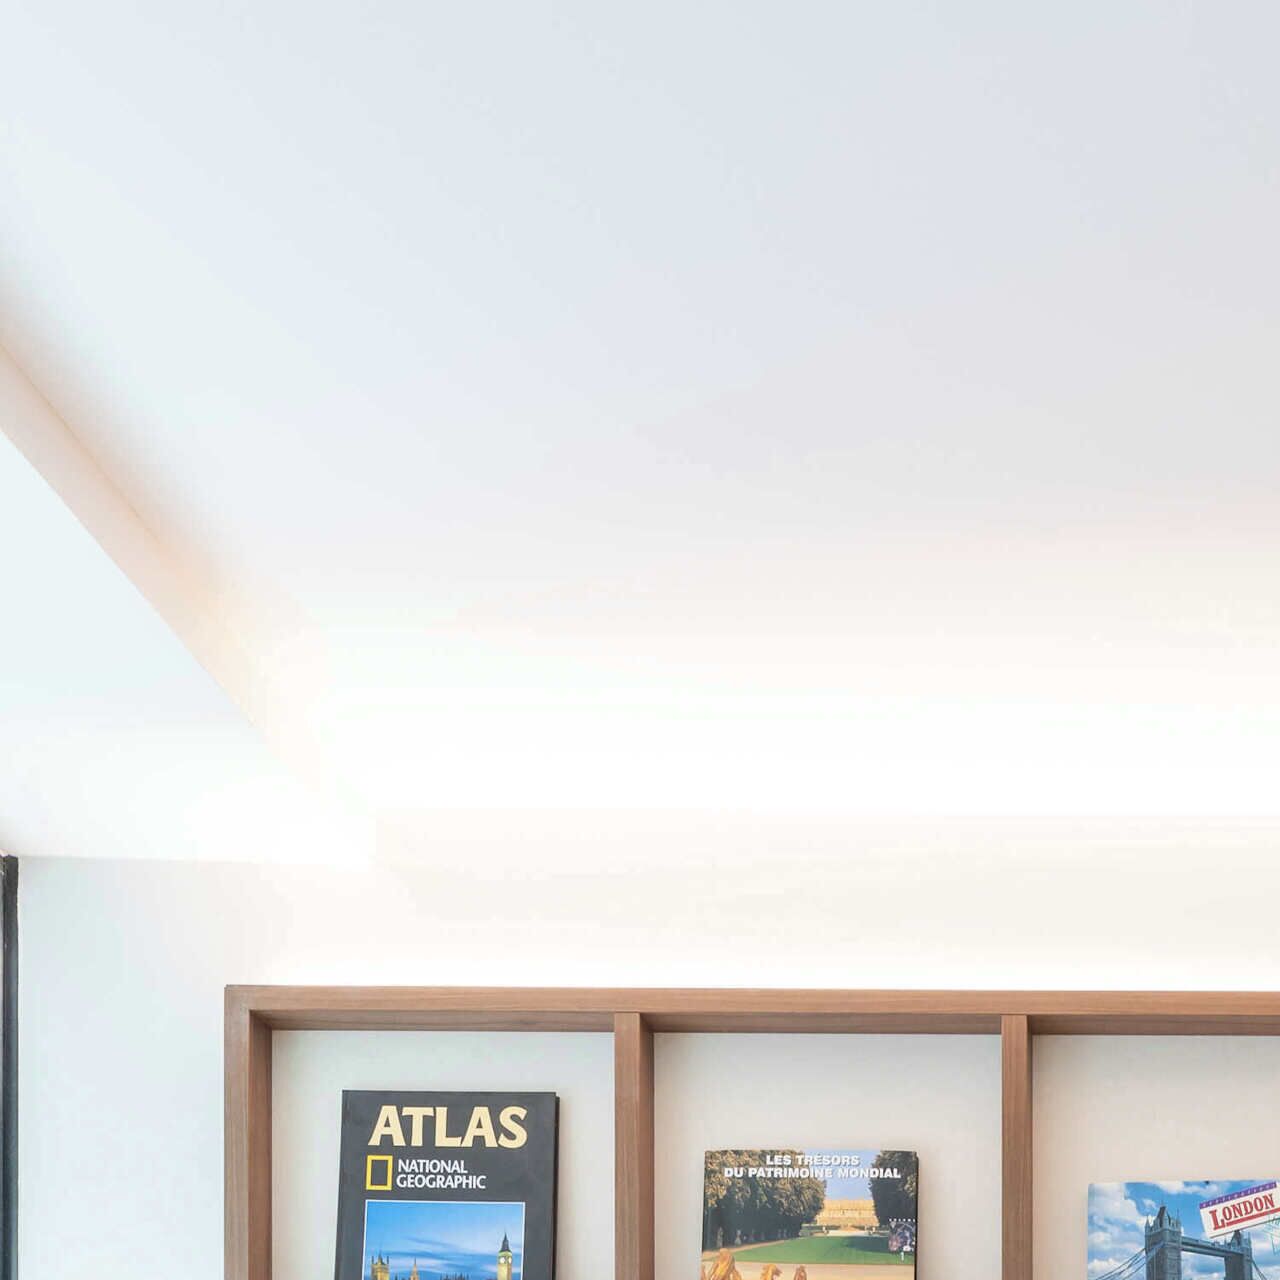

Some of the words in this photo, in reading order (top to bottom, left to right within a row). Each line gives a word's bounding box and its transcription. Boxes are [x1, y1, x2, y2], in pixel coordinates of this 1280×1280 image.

[367, 1105, 528, 1149] ATLAS
[398, 1159, 468, 1174] NATIONAL
[766, 1155, 791, 1165] LES
[724, 1168, 743, 1178] DU
[748, 1168, 833, 1179] PATRIMOINE
[838, 1168, 901, 1178] MONDIAL
[396, 1174, 486, 1189] GEOGRAPHIC
[1209, 1193, 1275, 1230] LONDON
